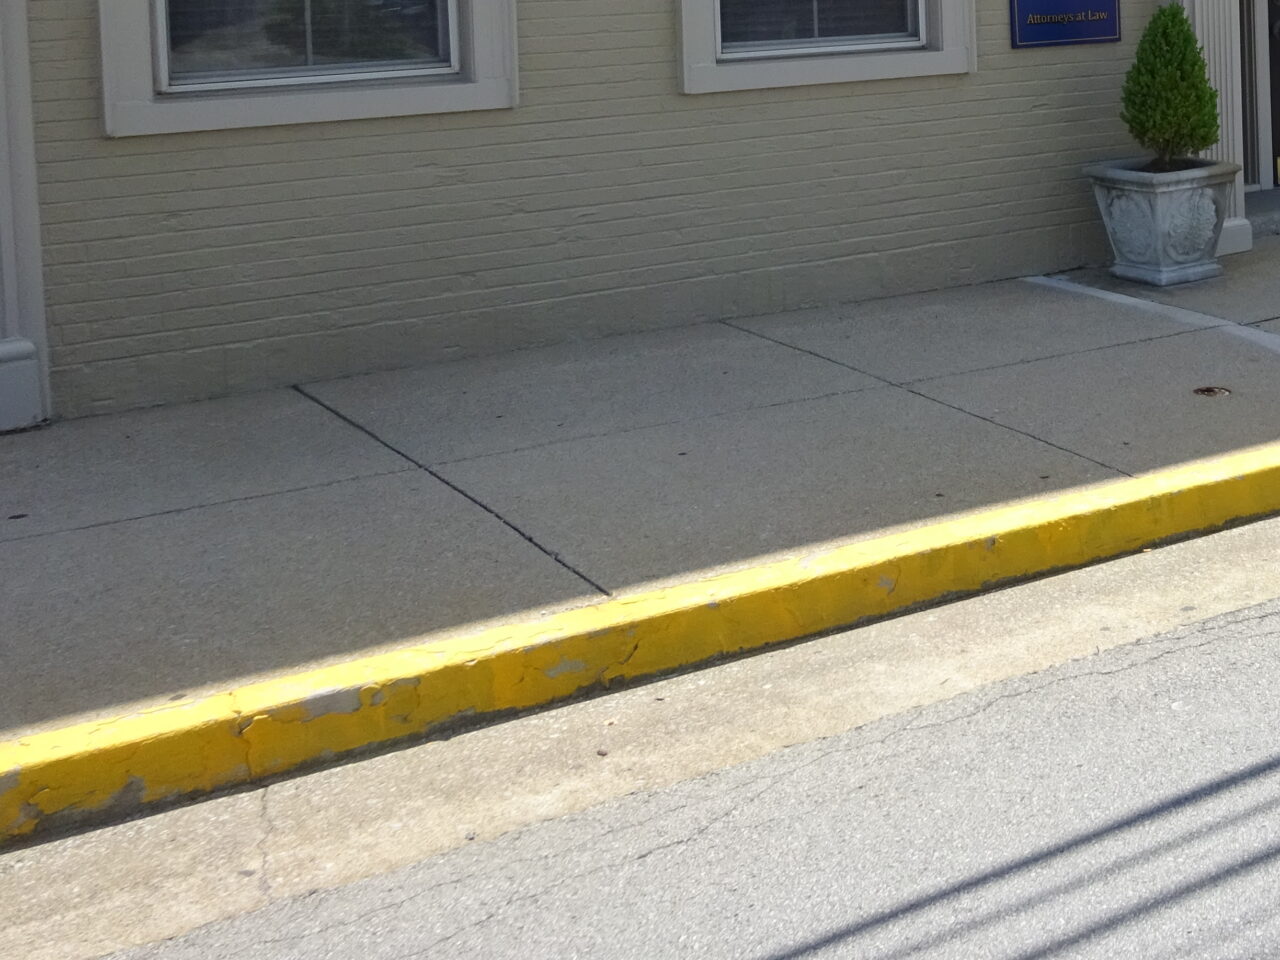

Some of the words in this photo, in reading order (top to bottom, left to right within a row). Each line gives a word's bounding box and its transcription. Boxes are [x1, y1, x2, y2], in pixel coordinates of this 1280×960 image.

[1027, 12, 1074, 25] Attorneys
[1076, 11, 1085, 21] at
[1088, 10, 1108, 21] Law
